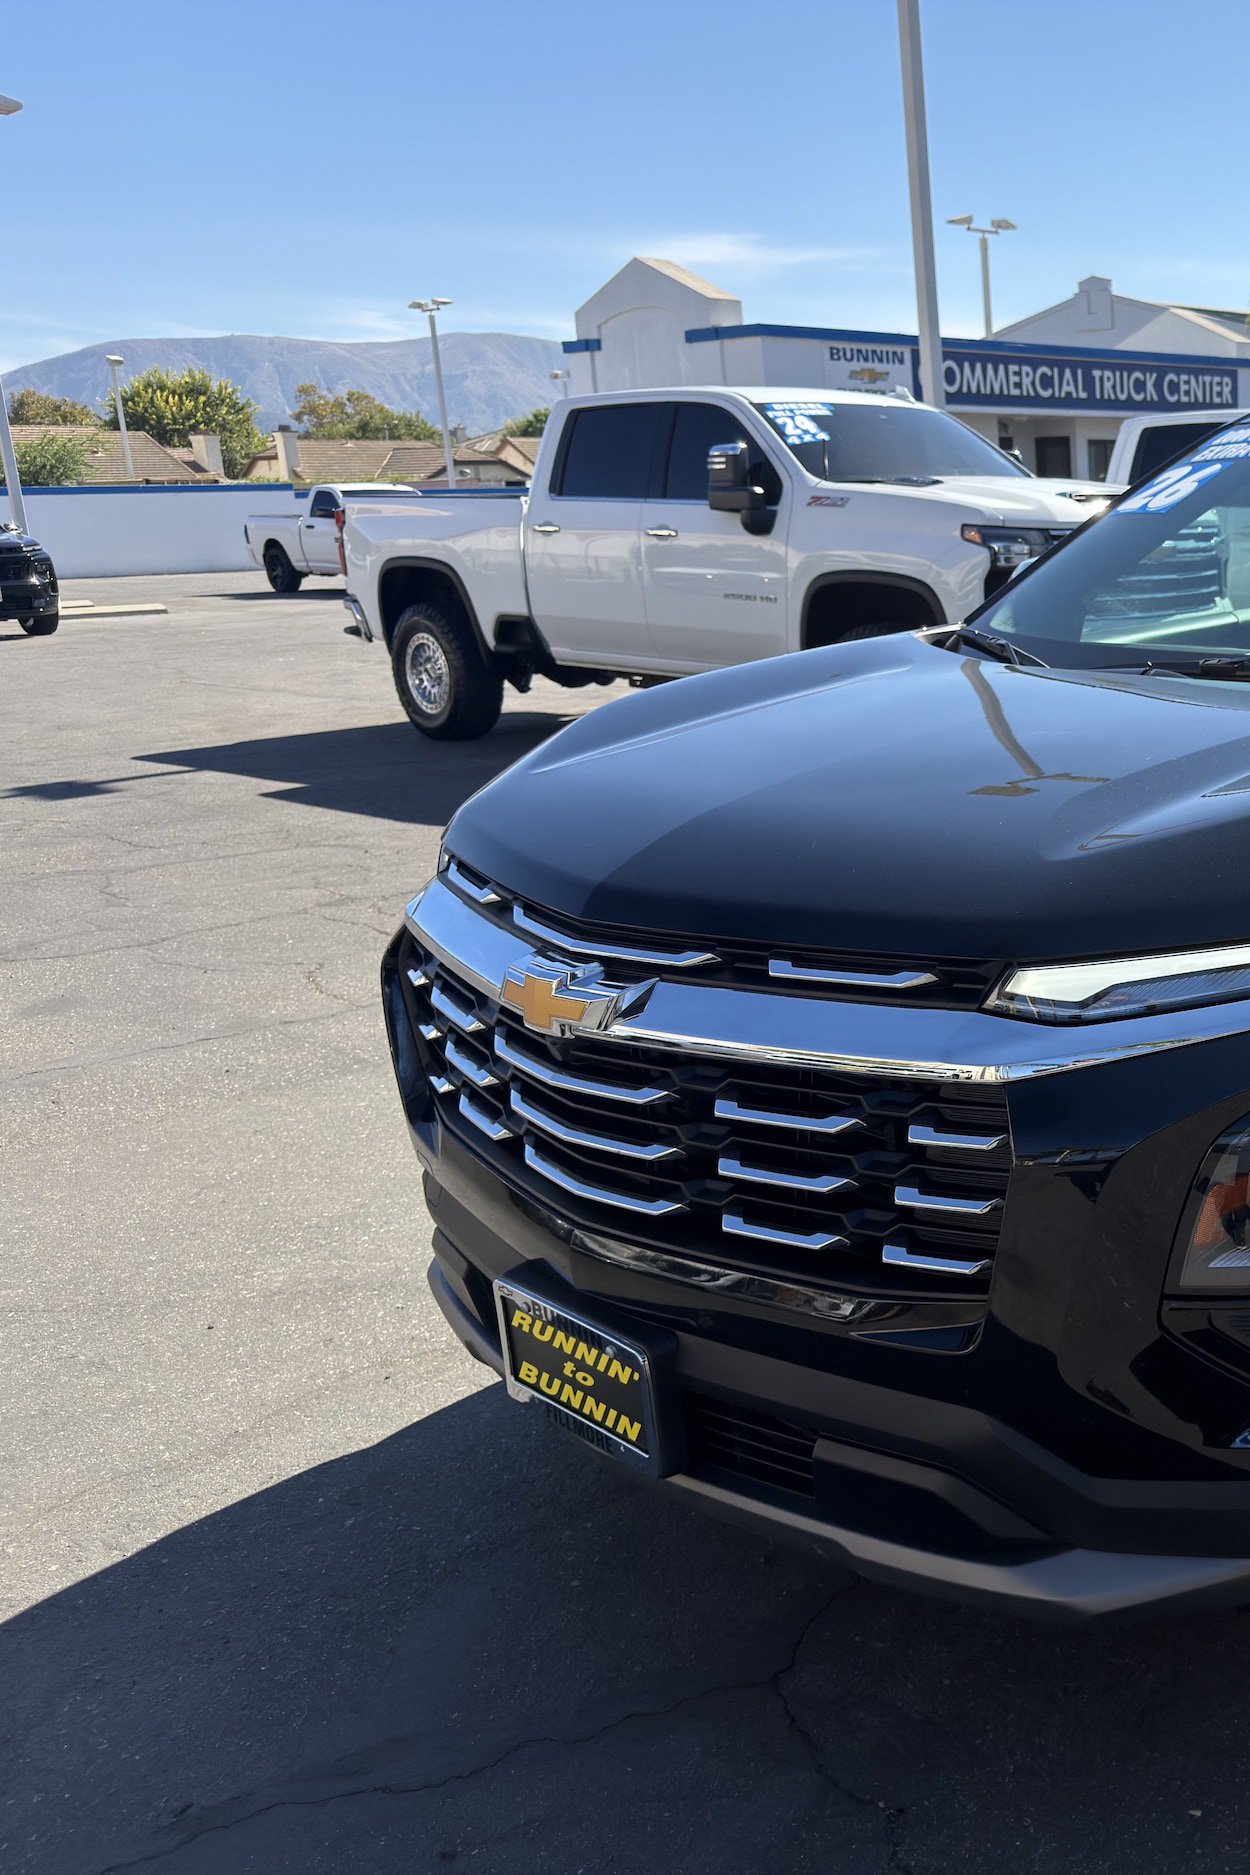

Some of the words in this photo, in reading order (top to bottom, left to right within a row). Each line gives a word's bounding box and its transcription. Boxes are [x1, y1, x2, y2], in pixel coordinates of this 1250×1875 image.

[829, 346, 905, 366] BUNNIN
[918, 358, 1088, 401] OMMERCIAL
[1091, 368, 1158, 403] TRUCK
[1162, 371, 1233, 405] CENTER
[774, 415, 821, 436] 24
[1115, 463, 1224, 513] 26
[511, 1309, 641, 1386] RUNNIN'
[562, 1359, 596, 1388] to
[518, 1360, 643, 1443] BUNNIN
[545, 1405, 615, 1453] FILLMORE
